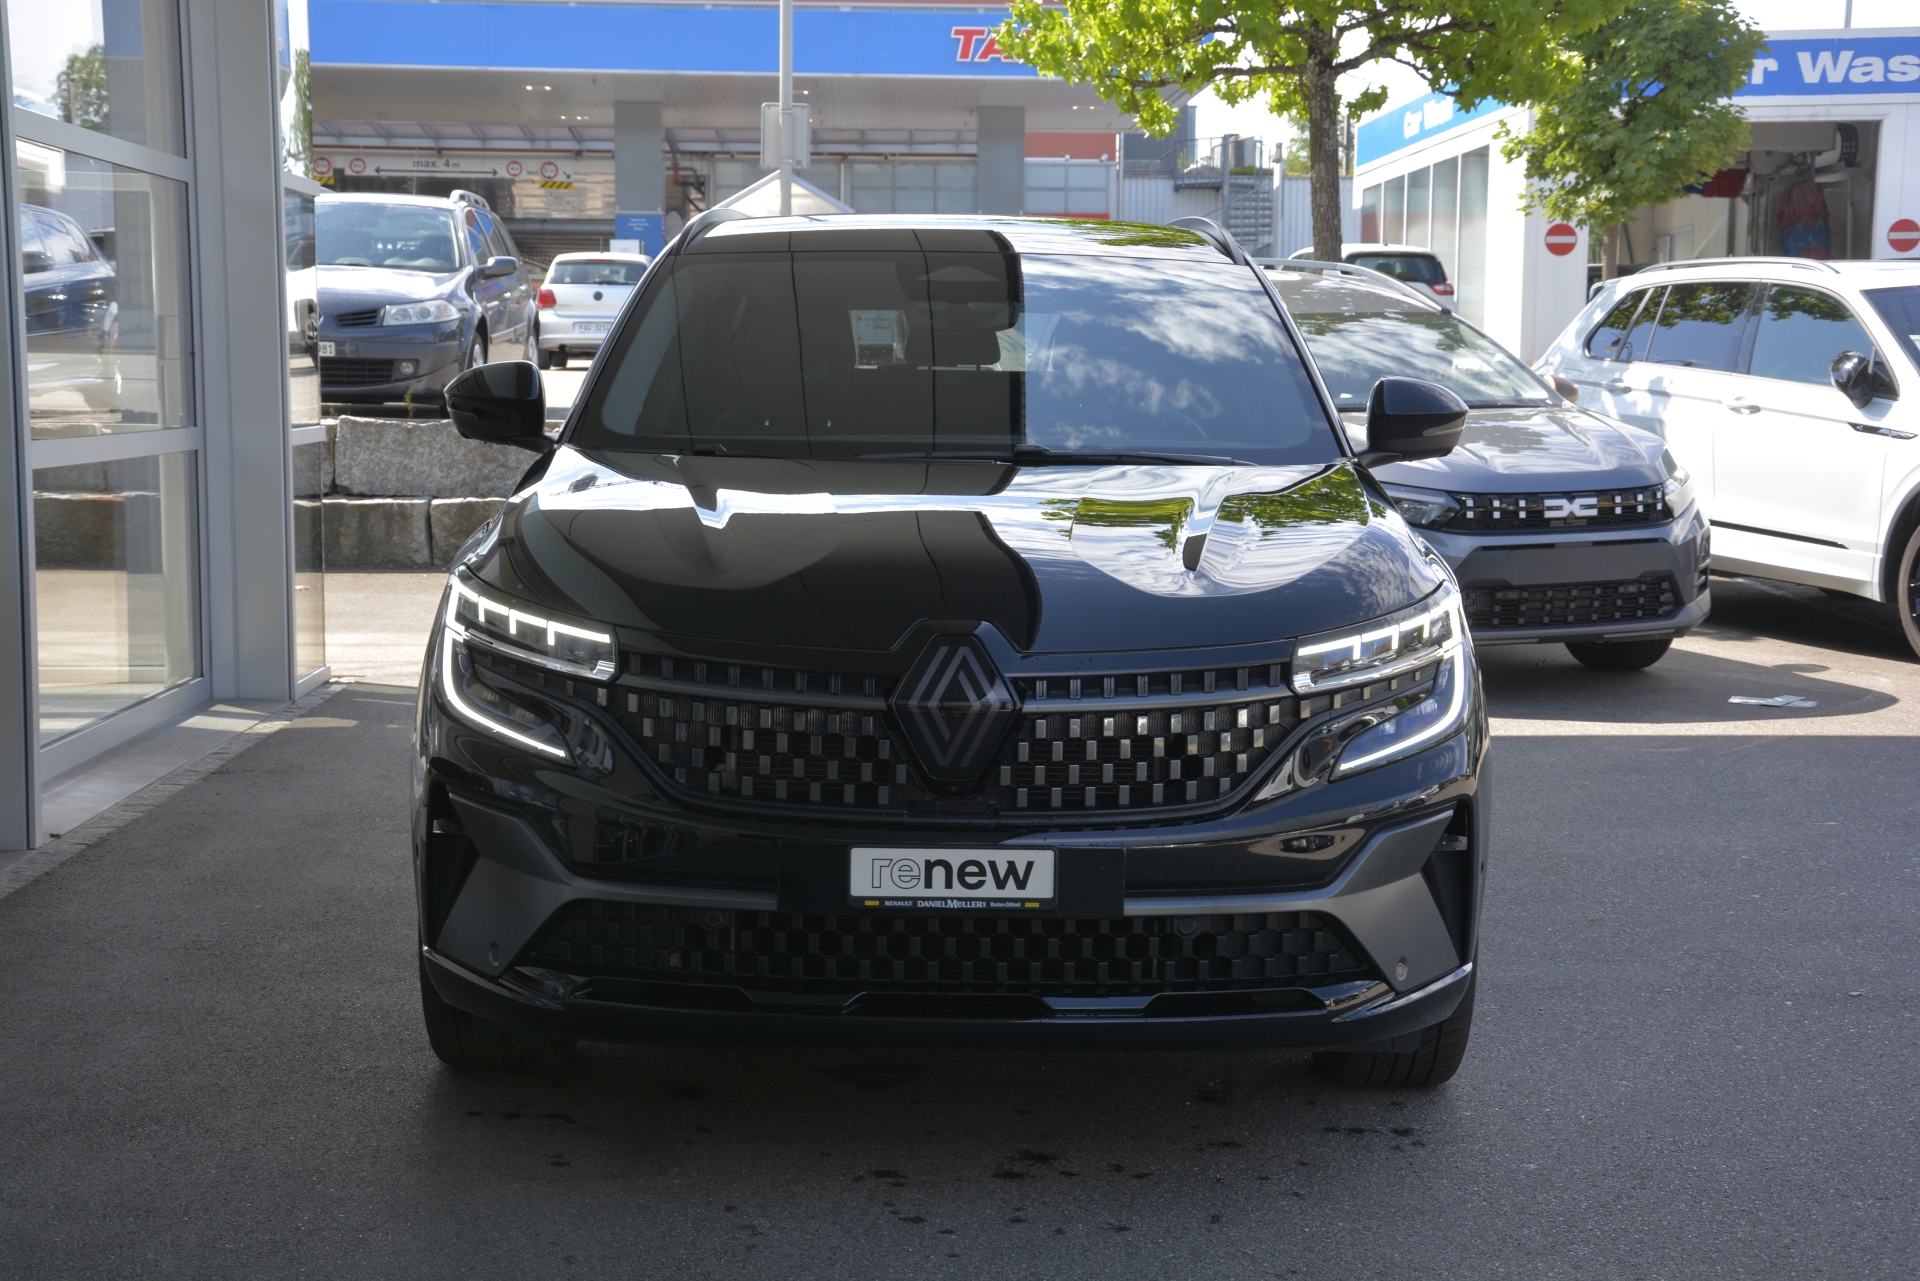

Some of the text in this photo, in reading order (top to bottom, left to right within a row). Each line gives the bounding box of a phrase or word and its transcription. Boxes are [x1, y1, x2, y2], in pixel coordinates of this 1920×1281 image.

[951, 26, 1033, 62] TA
[1743, 57, 1779, 85] r
[412, 160, 440, 168] max.
[443, 158, 450, 168] 4
[871, 858, 1035, 891] renew
